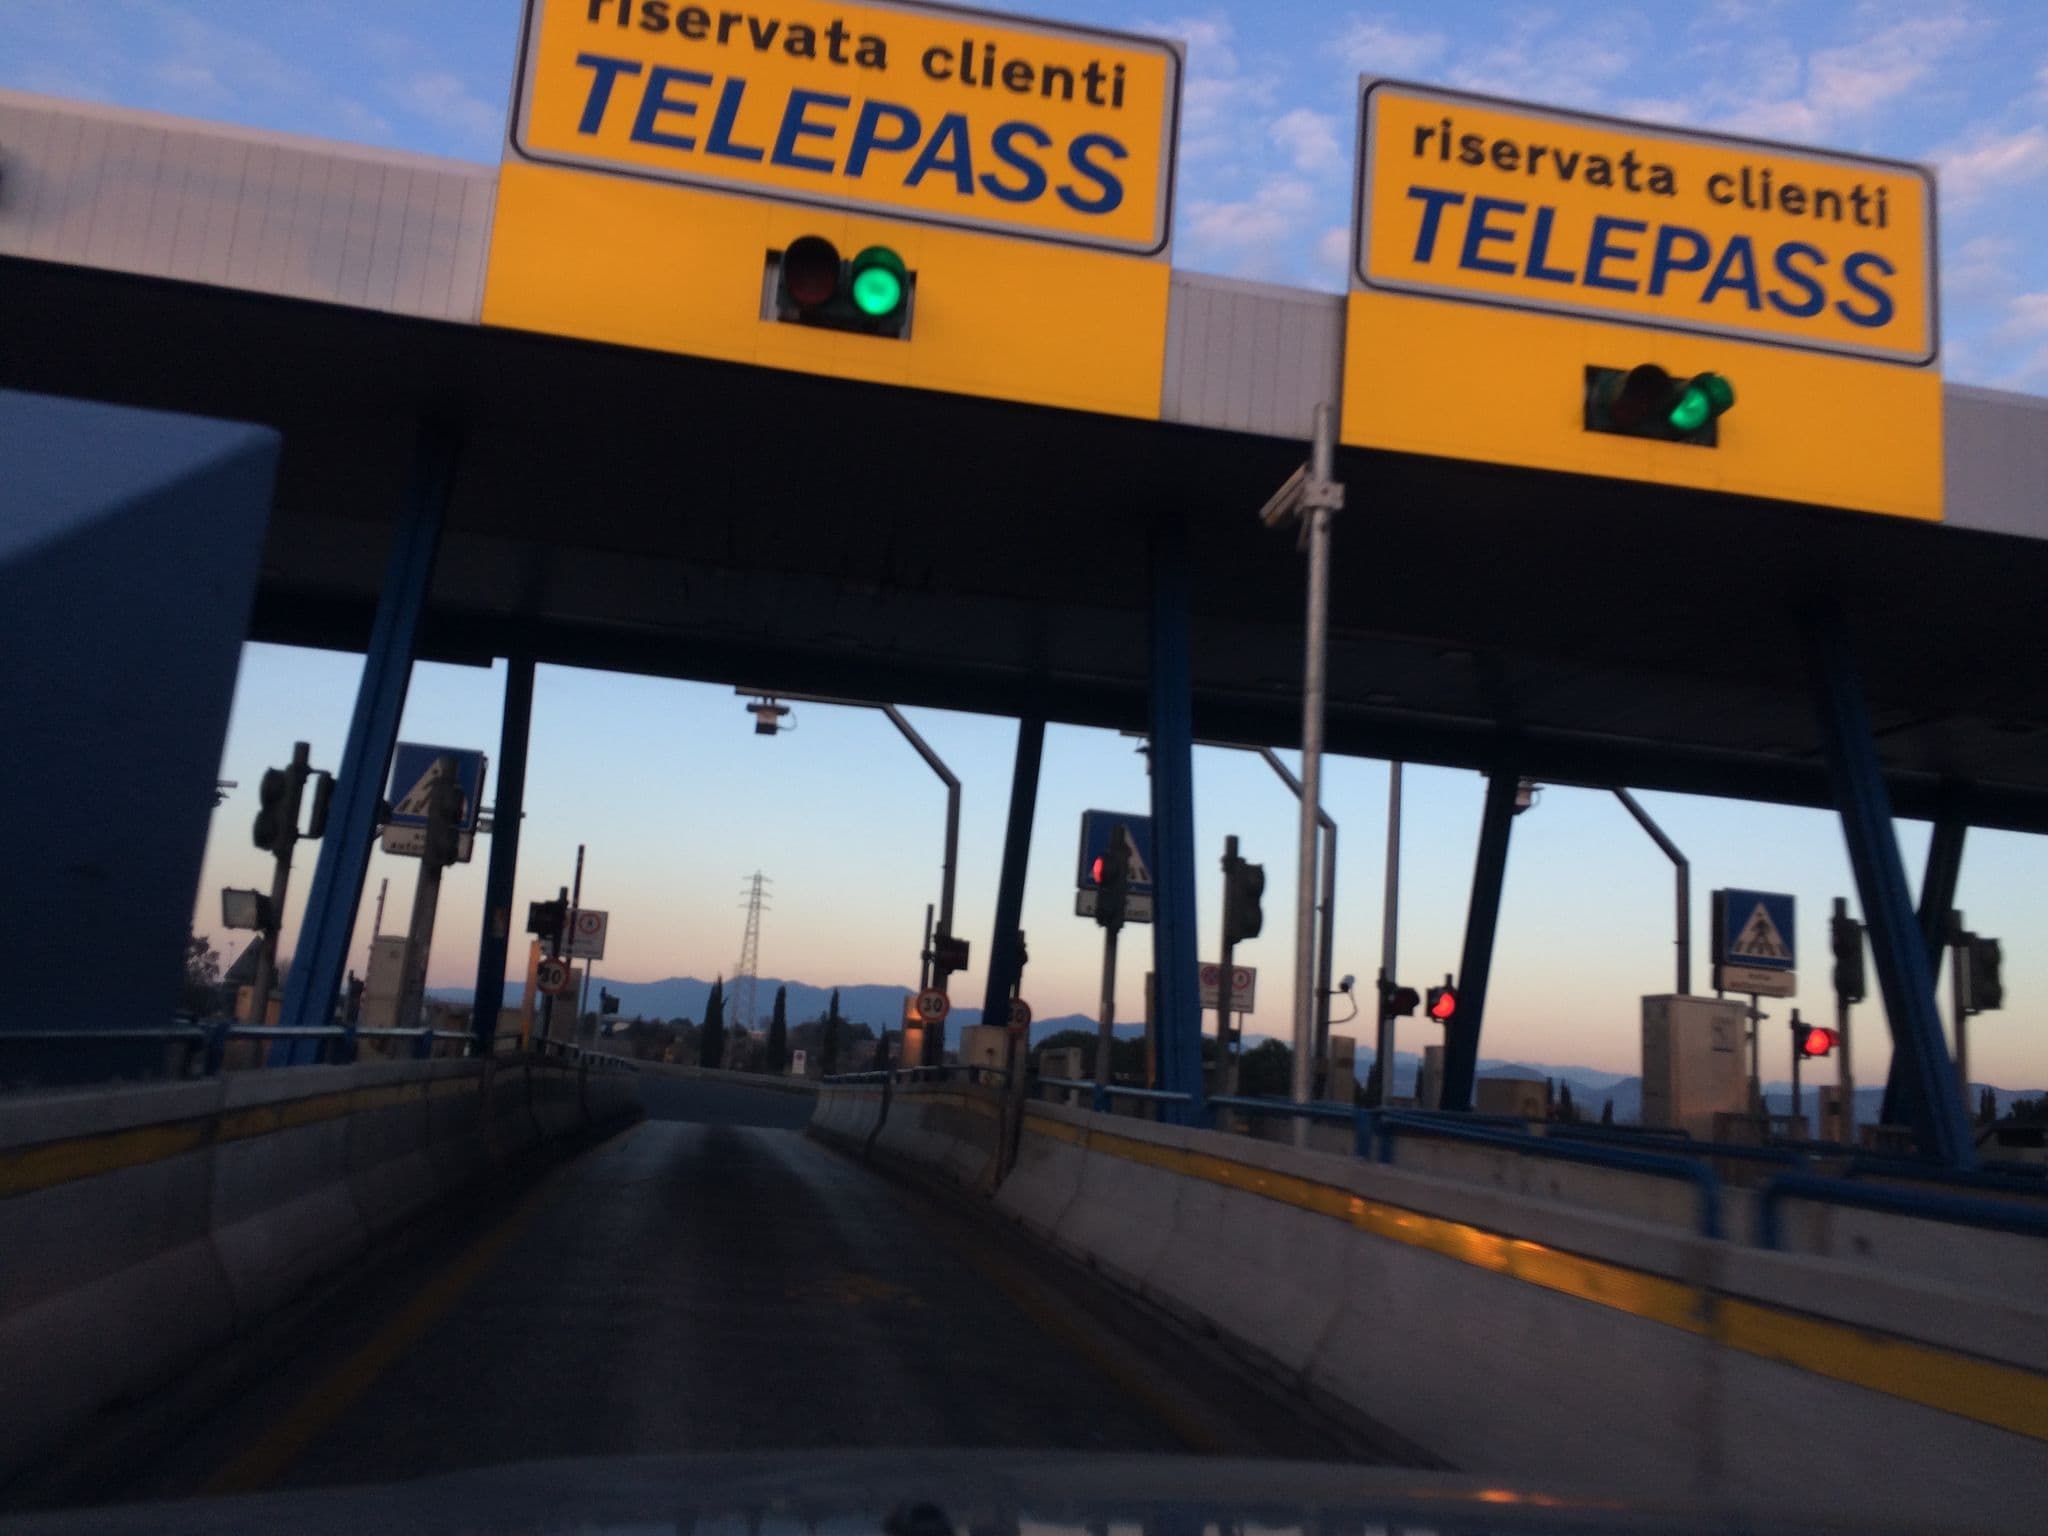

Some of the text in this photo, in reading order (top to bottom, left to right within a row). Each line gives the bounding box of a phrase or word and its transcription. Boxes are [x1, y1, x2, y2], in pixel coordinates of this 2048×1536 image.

[587, 0, 1126, 109] riservata clienti
[575, 52, 1129, 216] TELEPASS
[1412, 117, 1888, 229] riservata clienti
[1406, 185, 1896, 329] TELEPASS
[923, 997, 944, 1013] 30
